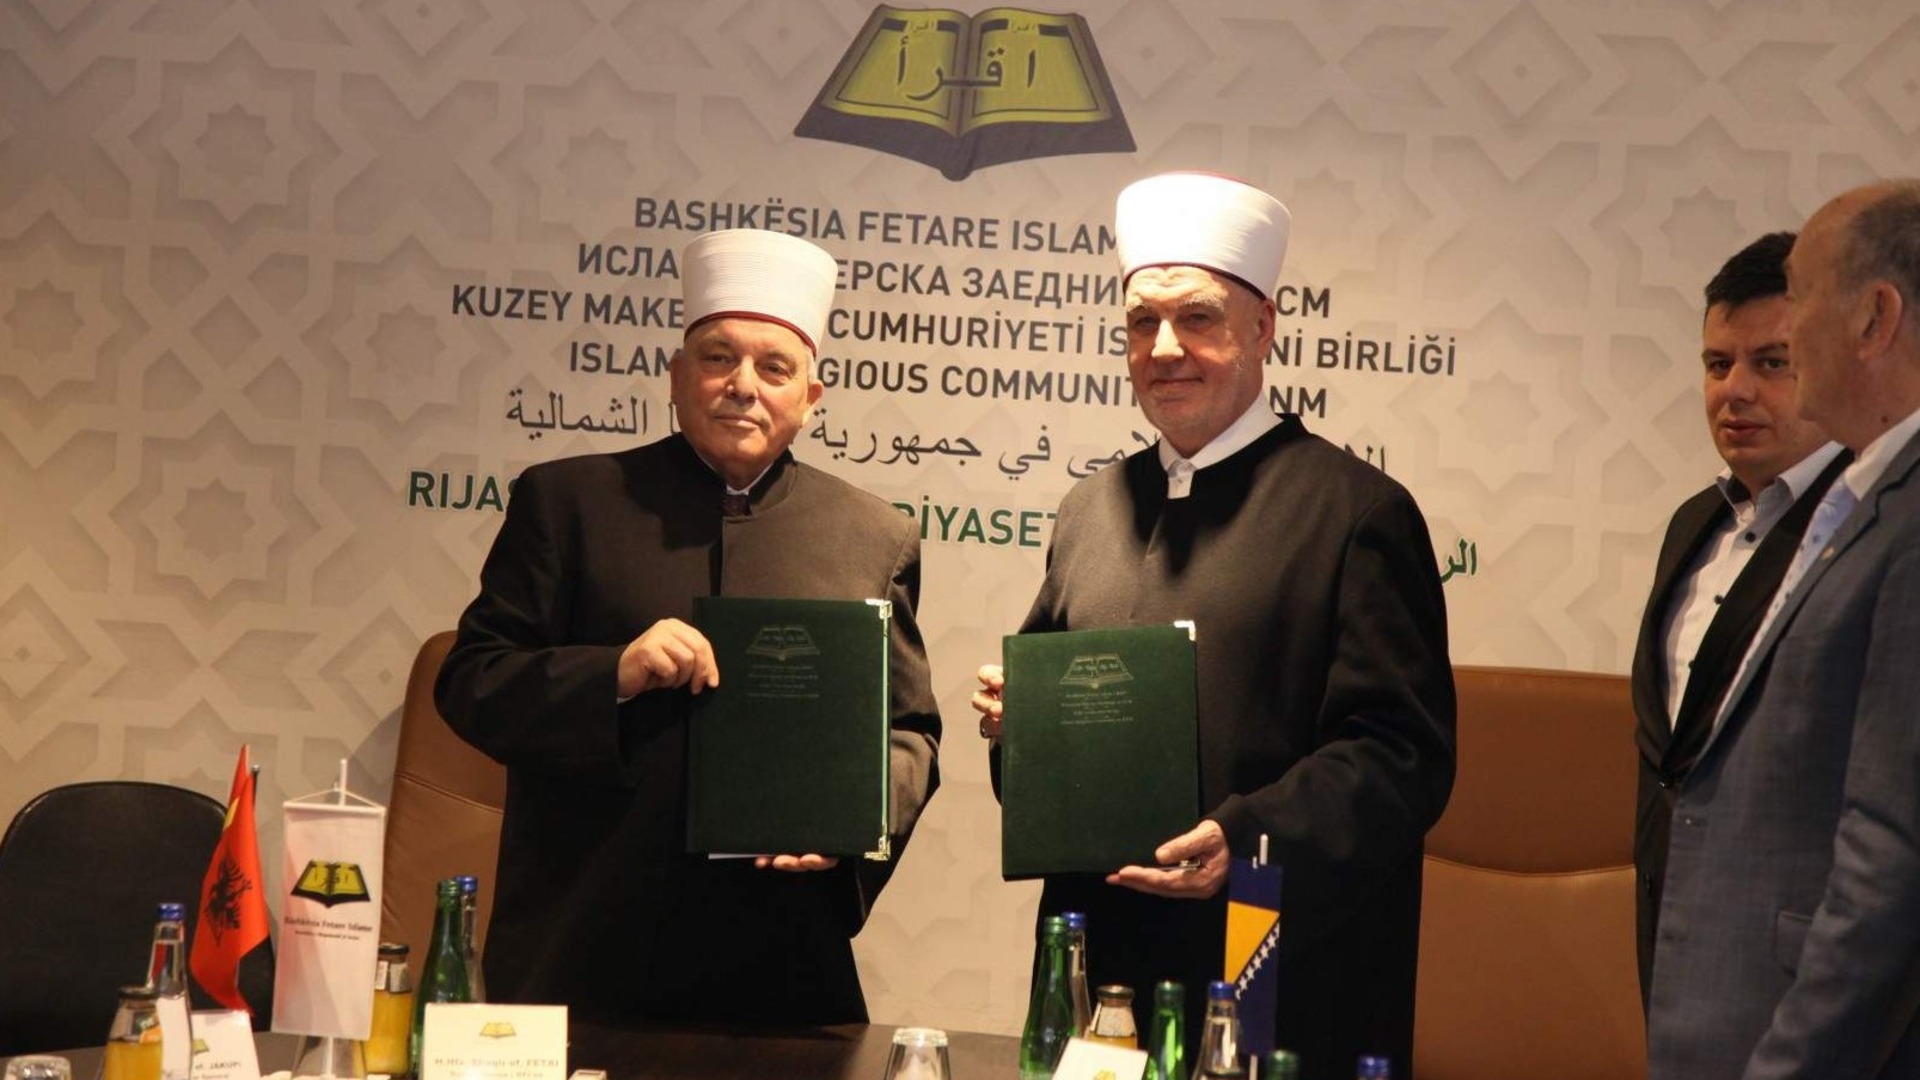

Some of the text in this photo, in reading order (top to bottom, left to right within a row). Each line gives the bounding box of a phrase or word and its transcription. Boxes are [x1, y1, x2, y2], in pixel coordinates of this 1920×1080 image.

[635, 197, 1118, 255] BASHKËSIA FETARE ISLAM
[578, 243, 1330, 318] ИСЛА ЕРСКА ЗАЕДНИ СМ
[452, 284, 572, 321] KUZEY
[828, 309, 1084, 354] CUMHURİYETİ
[1265, 328, 1303, 367] Nİ
[1316, 331, 1456, 376] BİRLİĞİ
[570, 341, 1327, 419] ISLAM GIOUS COMMUNIT NM
[506, 388, 648, 441] الشمالية
[810, 407, 982, 466] جمهورية
[998, 424, 1050, 481] في
